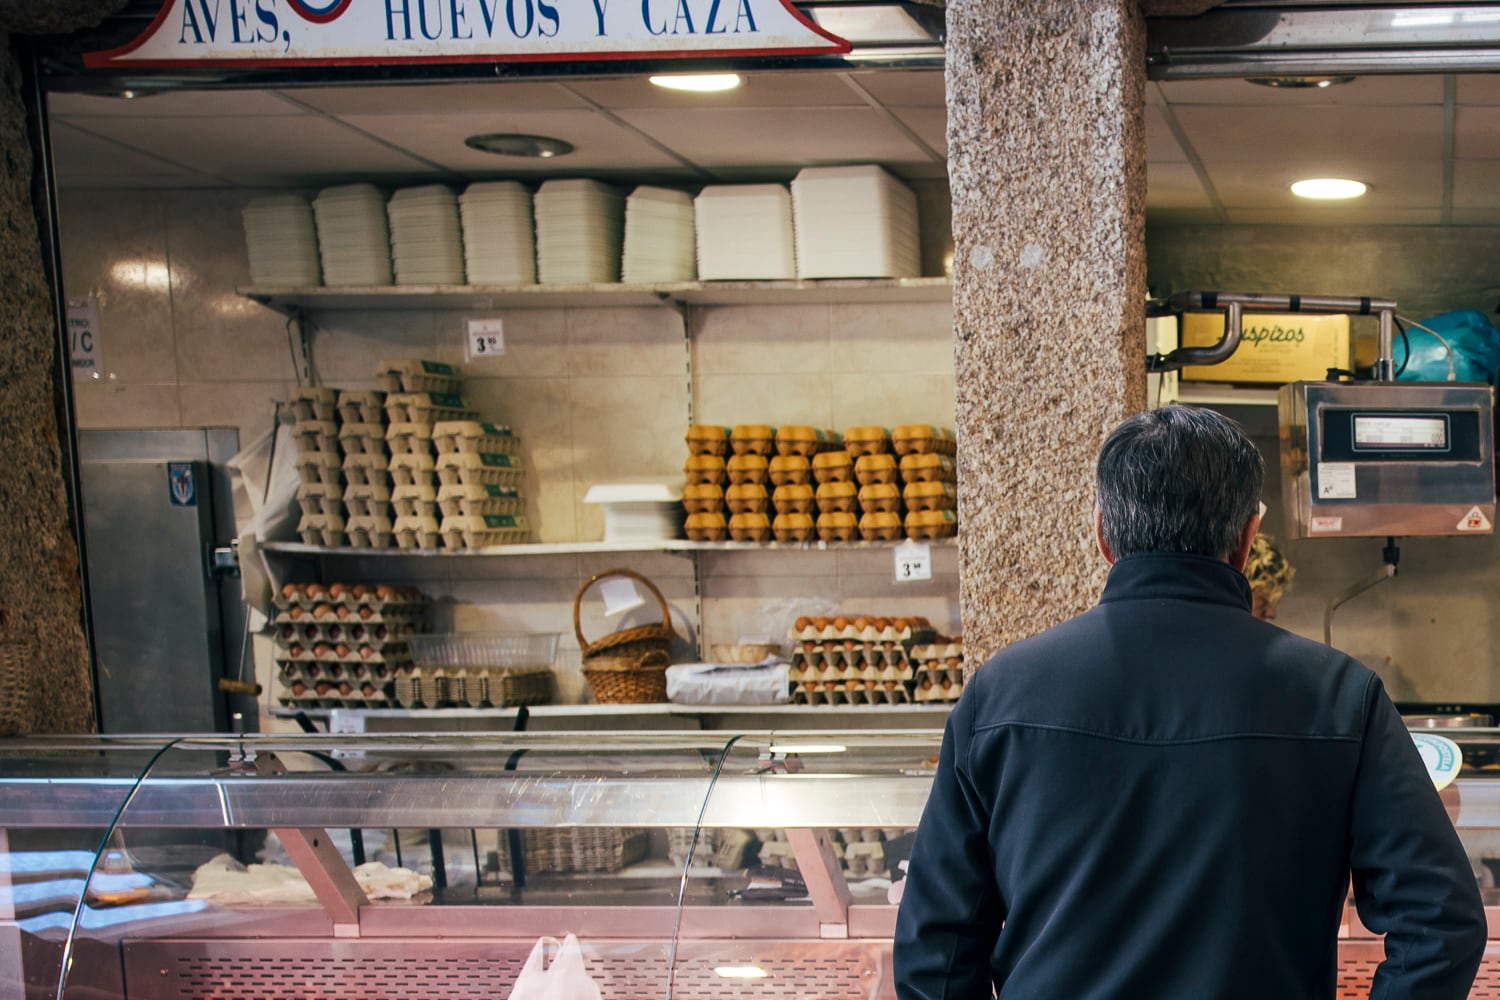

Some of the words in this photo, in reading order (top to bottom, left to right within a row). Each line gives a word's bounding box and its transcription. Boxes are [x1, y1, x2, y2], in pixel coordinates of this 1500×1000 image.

[178, 0, 291, 53] AVES,
[384, 0, 561, 41] HUEVOS
[592, 0, 610, 37] Y
[641, 0, 761, 35] CAZA
[477, 337, 486, 352] 3
[903, 563, 911, 577] 3
